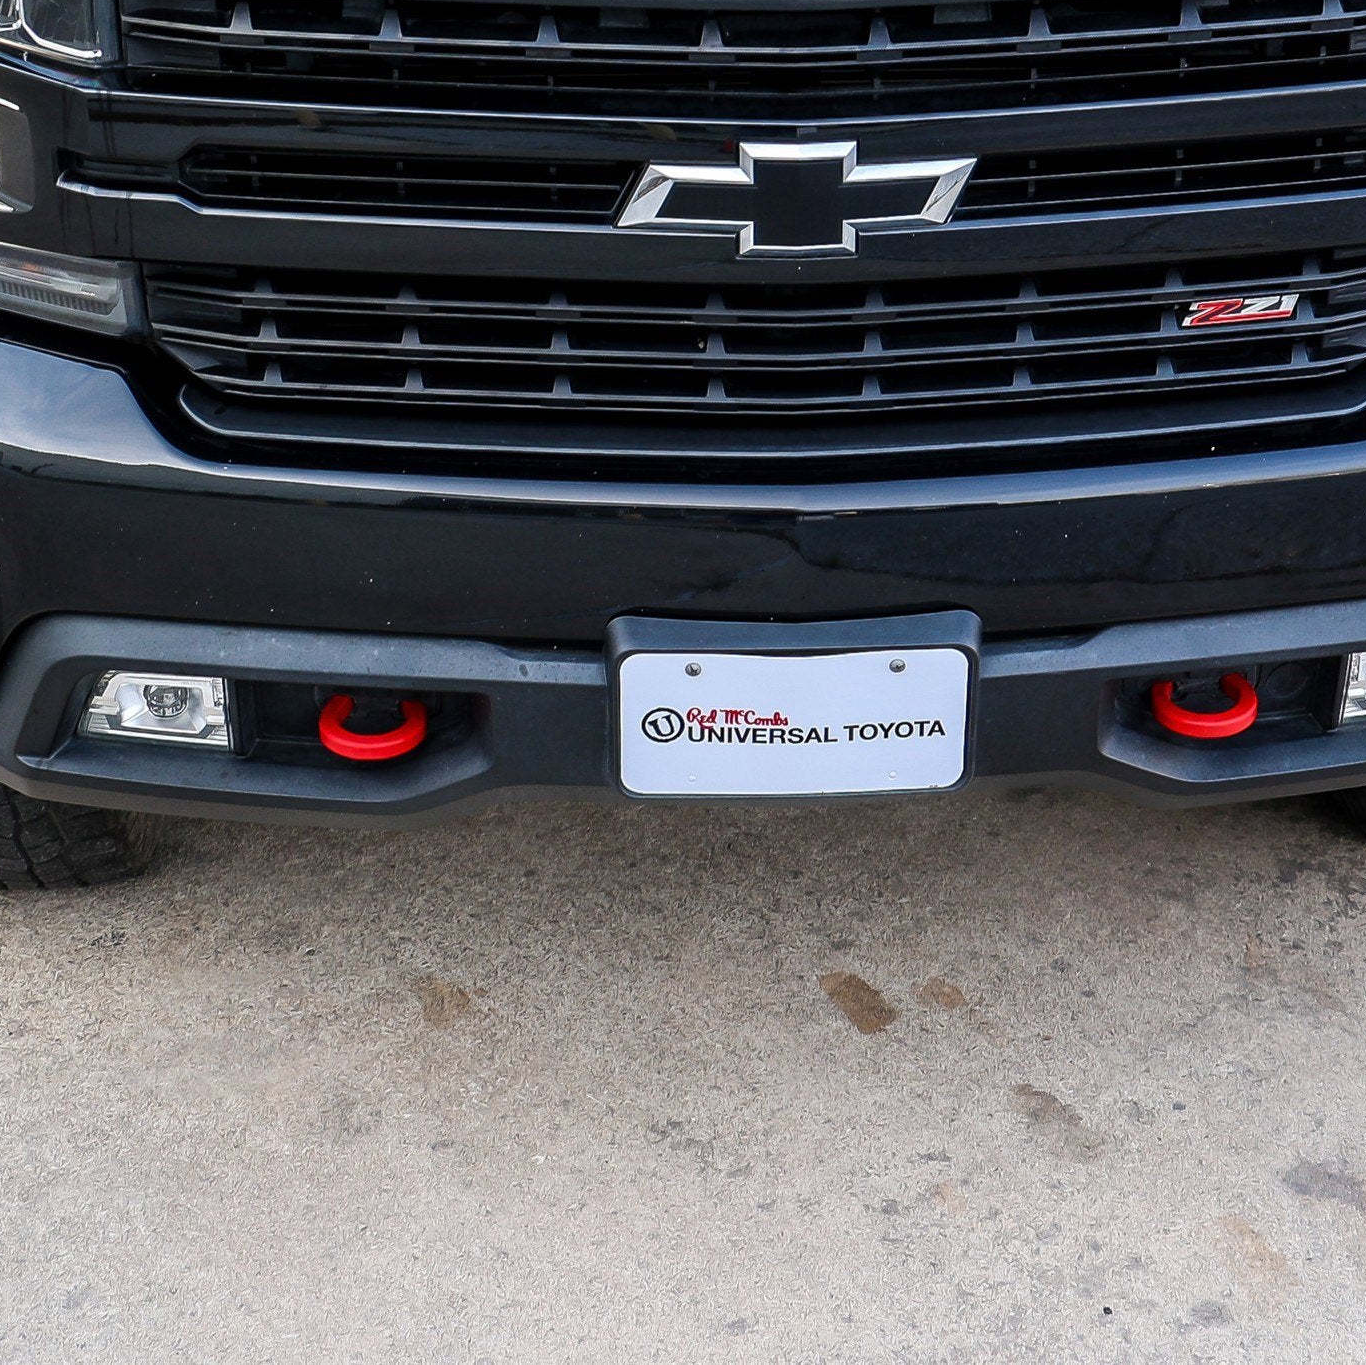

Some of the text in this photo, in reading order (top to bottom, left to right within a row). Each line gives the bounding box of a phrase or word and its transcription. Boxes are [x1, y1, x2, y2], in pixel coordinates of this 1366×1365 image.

[1182, 294, 1300, 326] Z71
[686, 707, 718, 729] Red
[688, 720, 946, 744] UNIVERSAL TOYOTA
